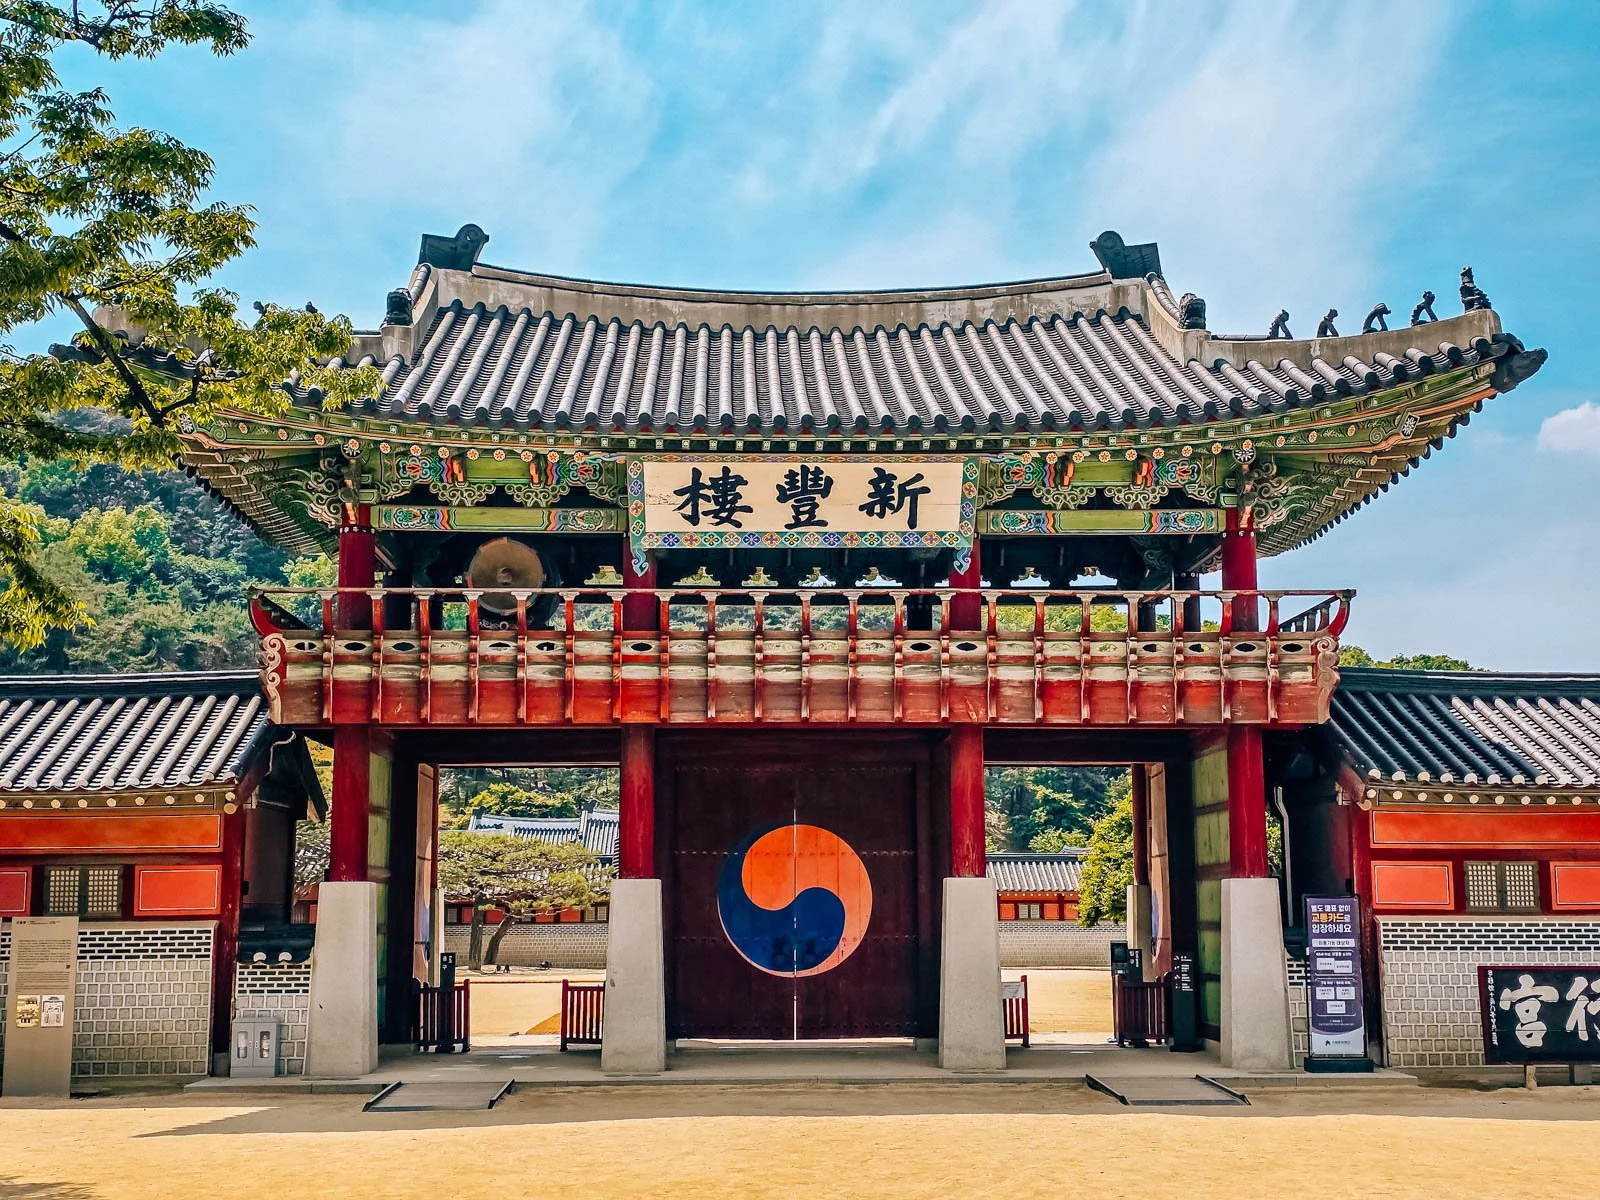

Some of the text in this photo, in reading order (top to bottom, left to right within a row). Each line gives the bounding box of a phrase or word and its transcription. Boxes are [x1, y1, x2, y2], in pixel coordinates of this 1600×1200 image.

[1338, 904, 1351, 912] 없이
[1311, 913, 1351, 923] 교통카드로
[1311, 923, 1352, 934] 입장하세요
